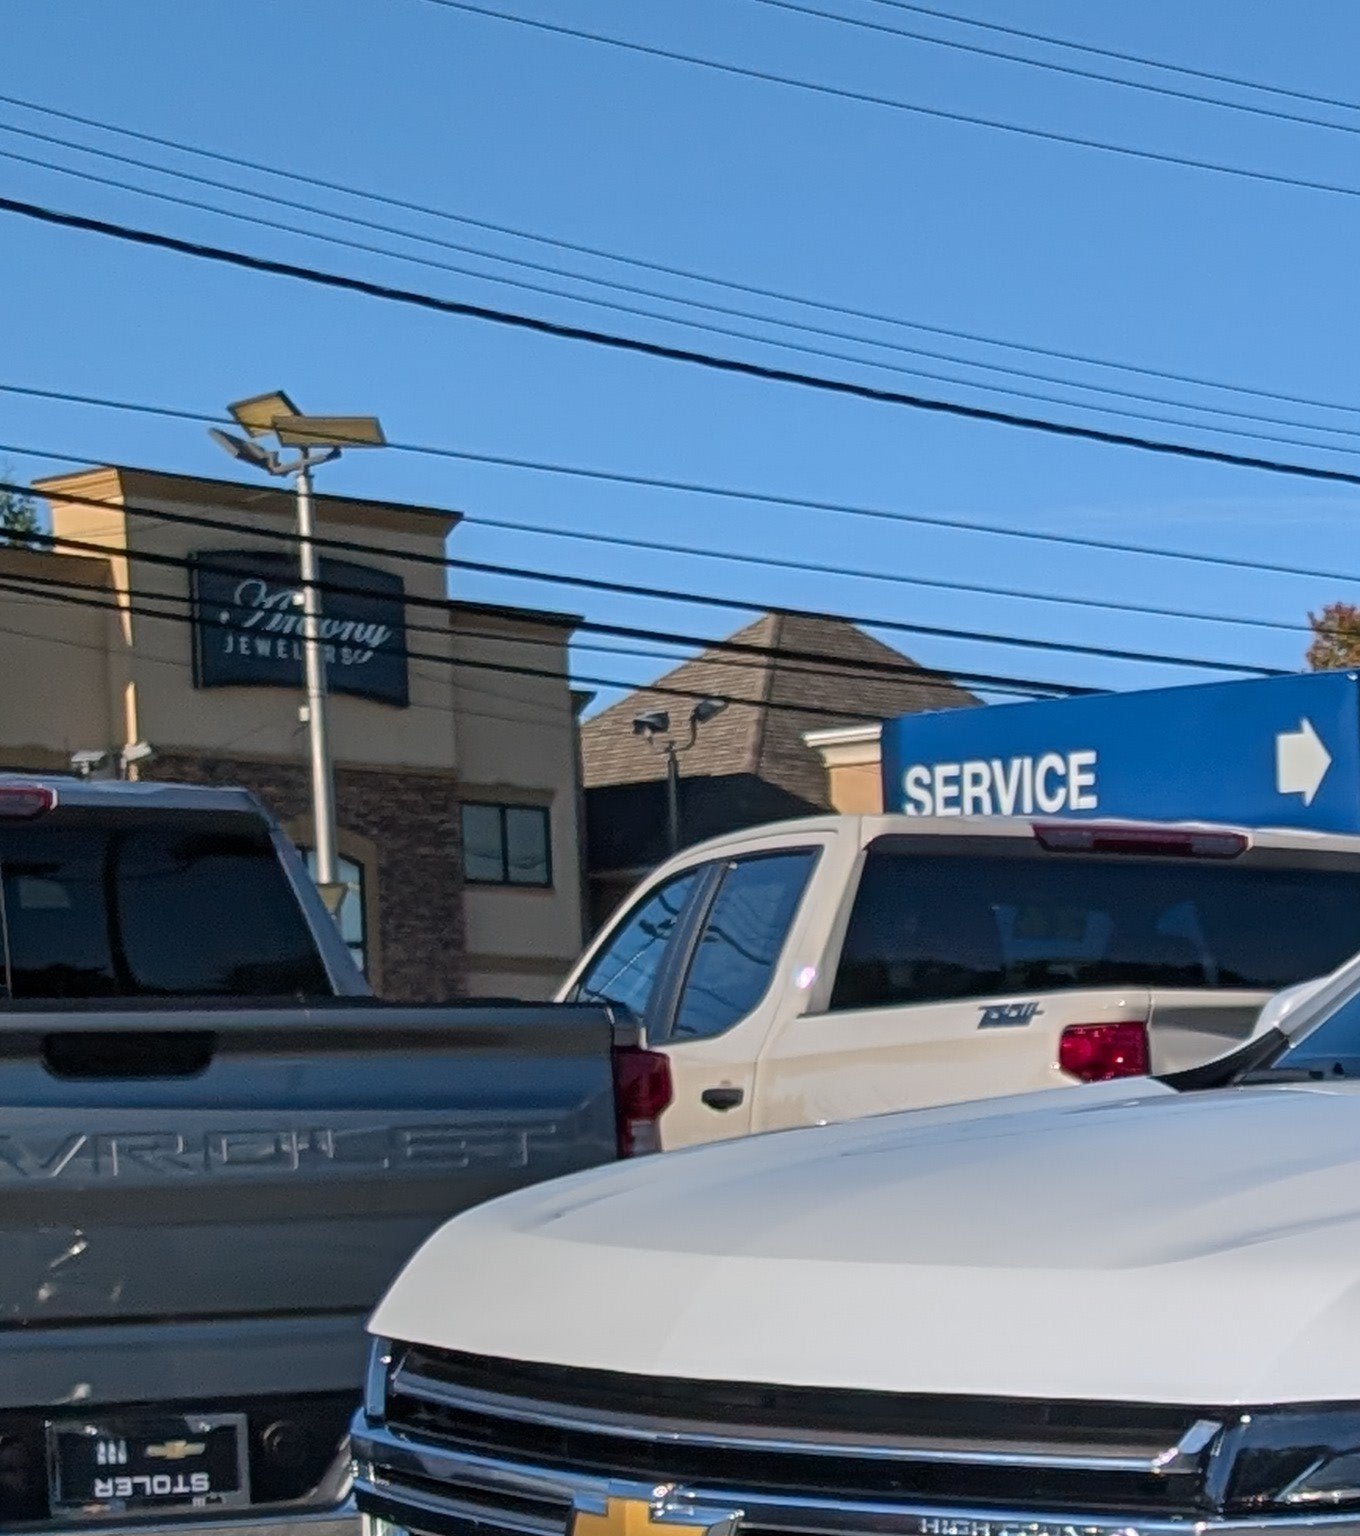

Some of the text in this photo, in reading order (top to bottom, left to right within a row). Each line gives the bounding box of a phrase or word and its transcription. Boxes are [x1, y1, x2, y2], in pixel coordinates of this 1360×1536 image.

[224, 632, 355, 665] JEWELRS
[903, 750, 1099, 818] SERVICE
[93, 1472, 211, 1498] STOLER
